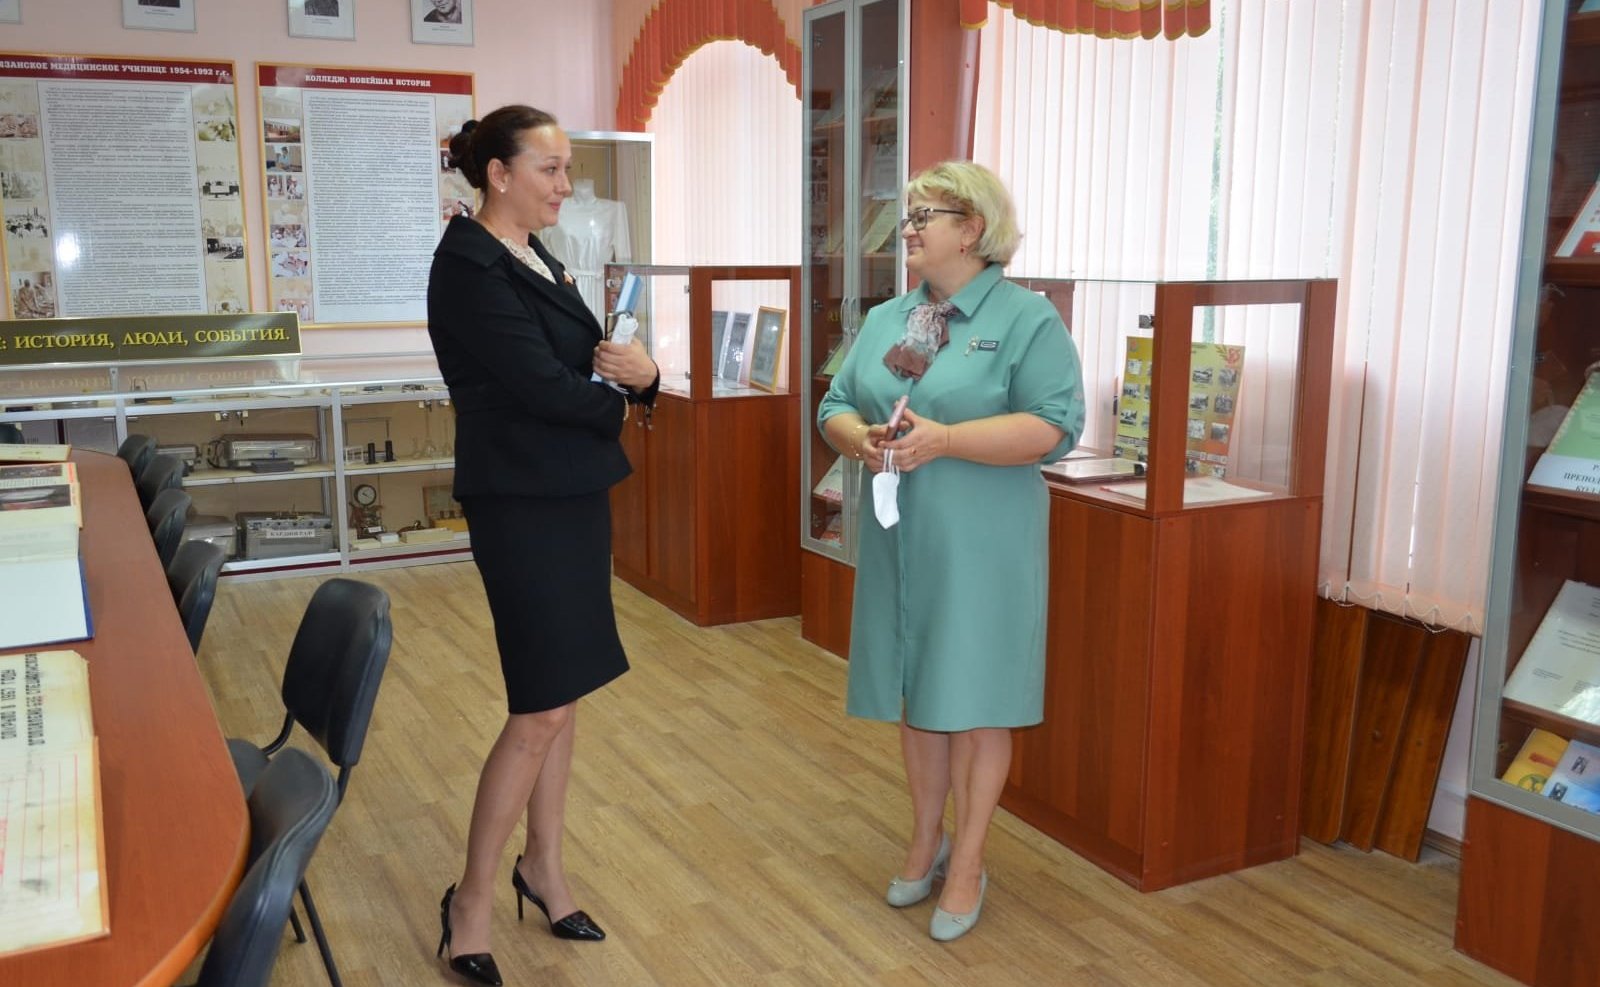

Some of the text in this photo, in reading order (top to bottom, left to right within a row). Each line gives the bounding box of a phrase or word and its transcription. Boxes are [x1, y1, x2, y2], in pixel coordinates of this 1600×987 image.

[50, 62, 119, 72] МЕДИЦИНСКОЕ
[121, 65, 167, 74] УЧИЛИЩЕ
[170, 66, 213, 75] 1954-1992
[349, 76, 394, 85] НОВЕЙШАЯ
[396, 79, 431, 87] ИСТОРИЯ
[14, 333, 115, 349] ИСТОРИЯ,
[122, 331, 188, 346] ЛЮДИ,
[194, 328, 290, 343] СОБЫТИЯ.
